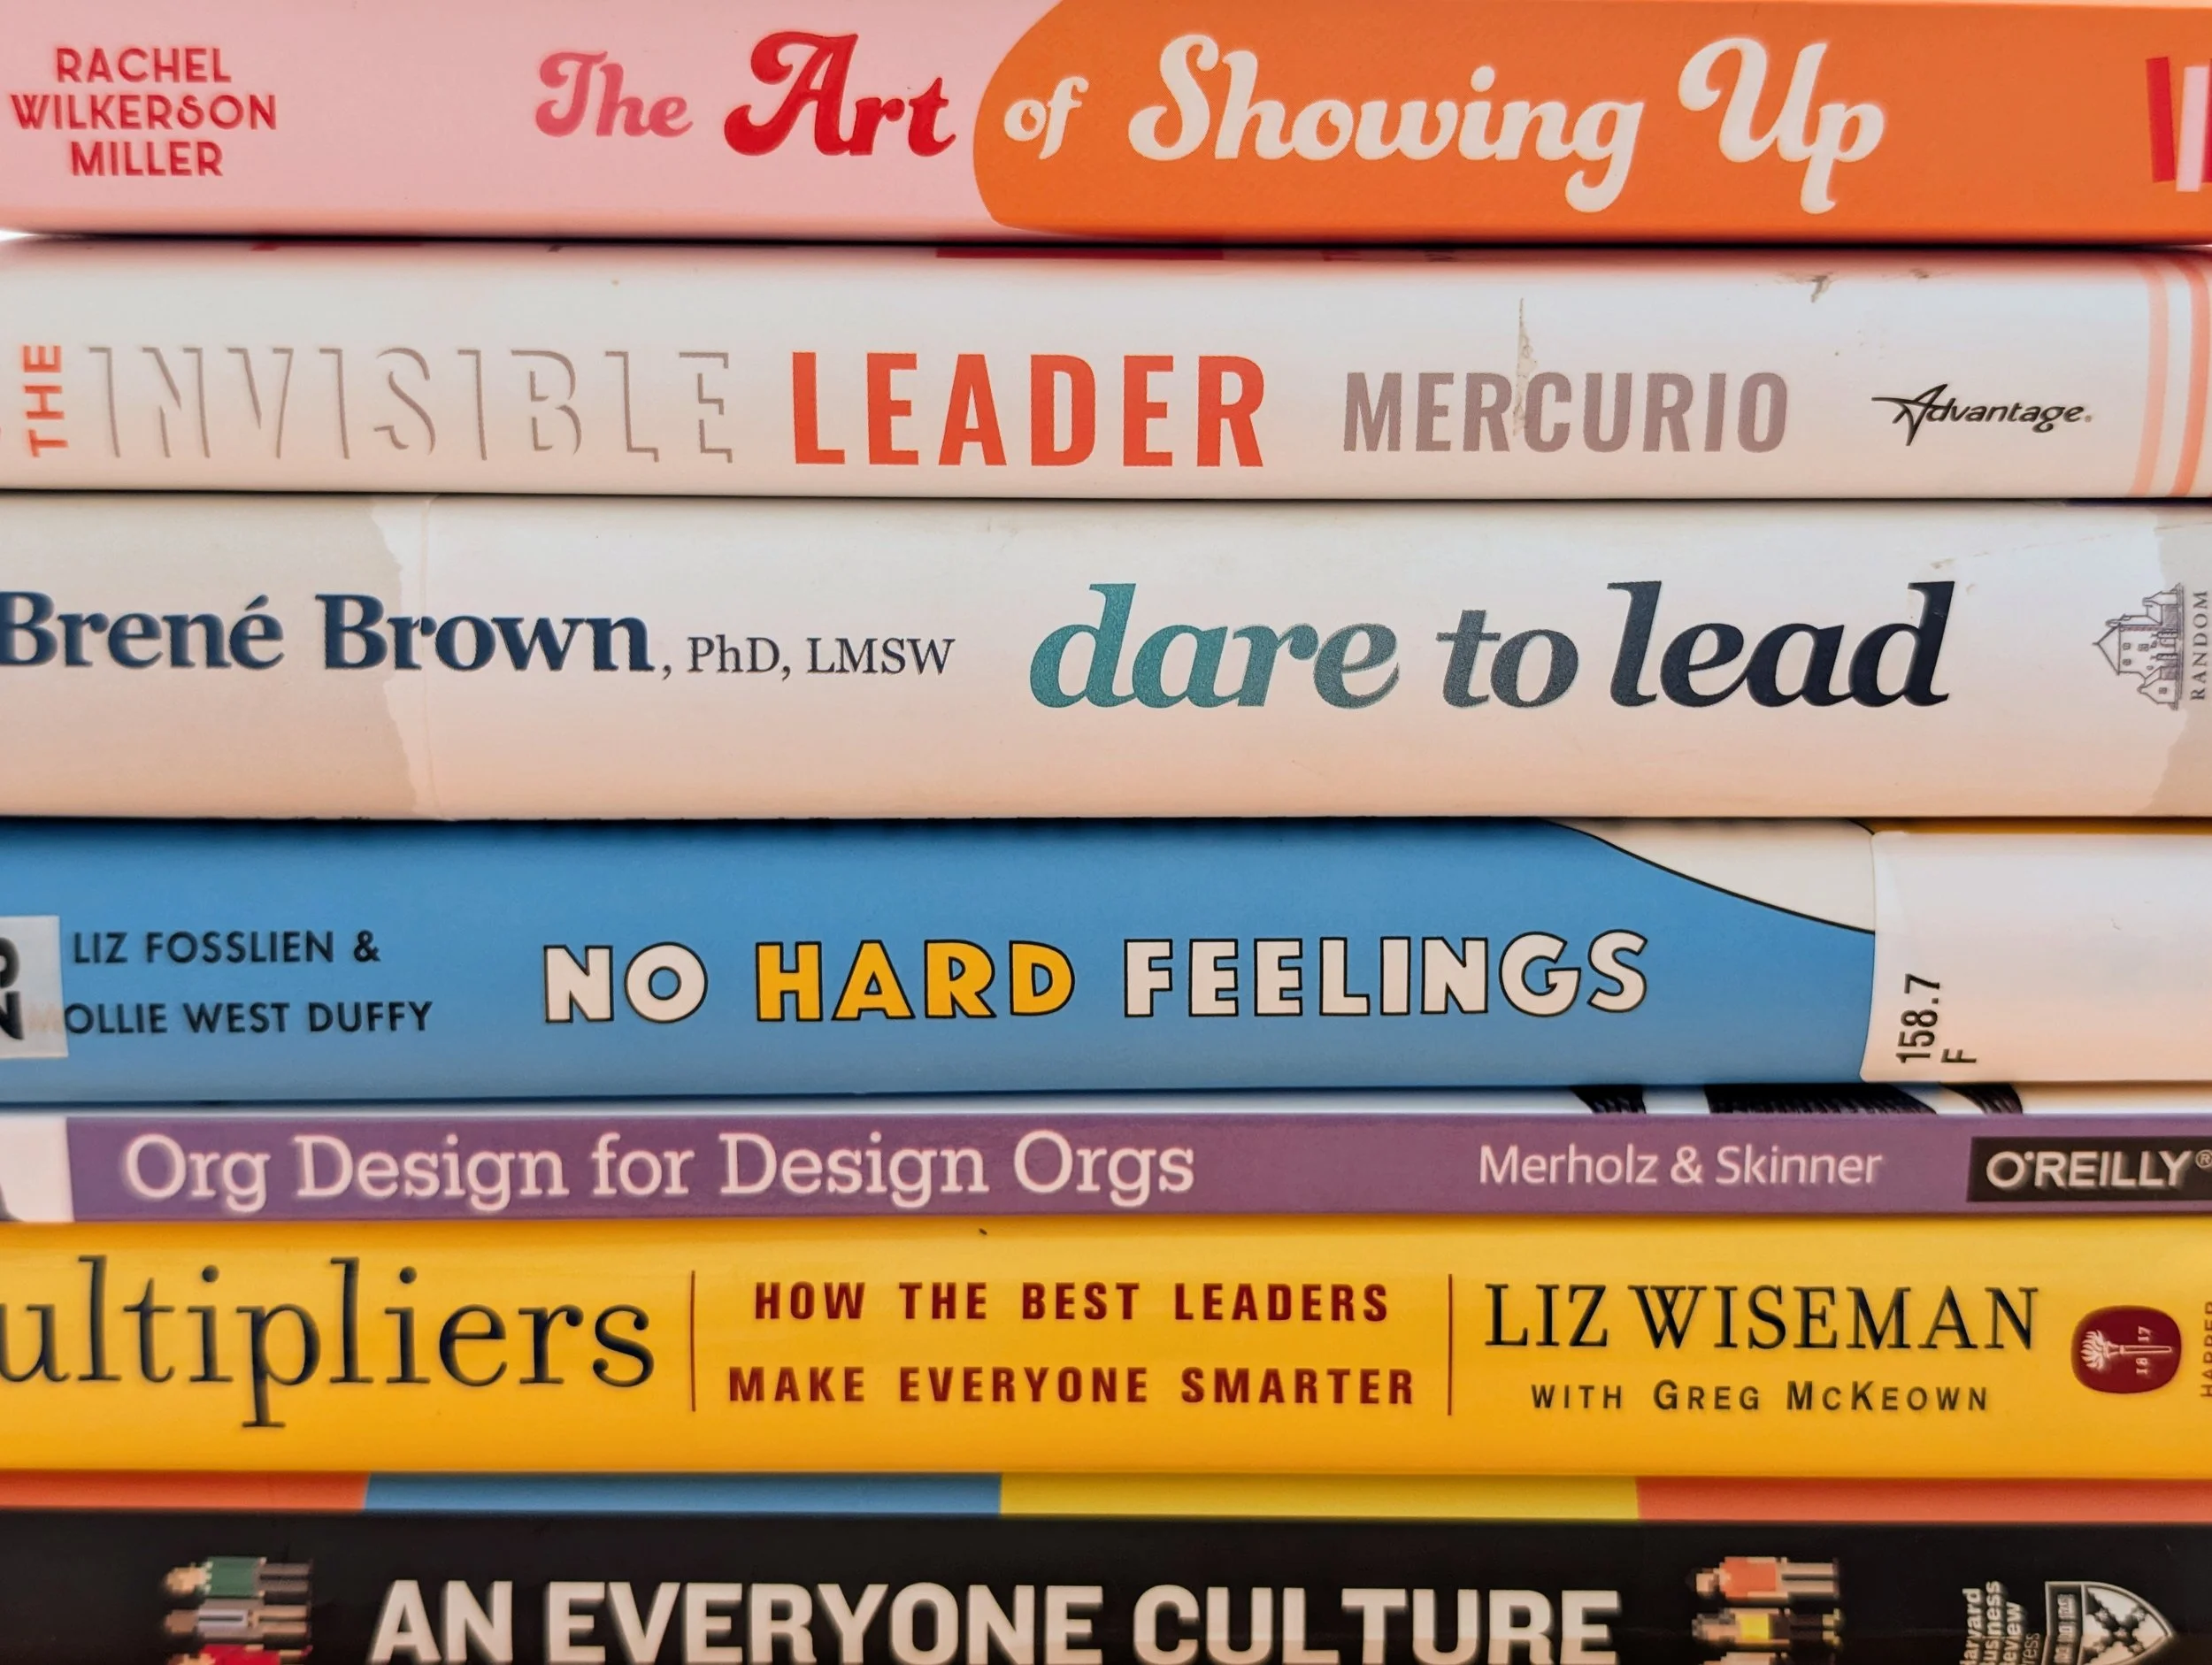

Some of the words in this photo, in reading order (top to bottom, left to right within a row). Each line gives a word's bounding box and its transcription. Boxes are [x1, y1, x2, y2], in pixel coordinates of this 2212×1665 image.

[56, 47, 232, 83] RACHEL
[11, 94, 277, 130] WILKERSON
[534, 50, 694, 138] The
[724, 32, 956, 157] Art
[1002, 76, 1088, 160] of
[1128, 34, 1644, 212] Showing
[1678, 37, 1884, 214] Up
[71, 141, 223, 176] MILLER
[22, 345, 68, 457] THE
[88, 347, 733, 463] INVISIBLE
[792, 351, 1264, 468] LEADER
[1343, 372, 1787, 453] MERCURIO
[0, 591, 285, 670] Brené
[315, 593, 672, 680] Brown,
[687, 636, 791, 681] PhD,
[807, 637, 956, 675] LMSW
[1029, 582, 1400, 709] dare
[1436, 609, 1579, 708] to
[1607, 579, 1955, 708] lead
[2190, 591, 2208, 701] RANDOM
[74, 932, 128, 963] LIZ
[145, 930, 334, 964] FOSSLIEN
[354, 930, 381, 964] &
[542, 940, 709, 1024] NO
[755, 939, 1076, 1023] HARD
[1123, 929, 1648, 1018] FEELINGS
[62, 1001, 168, 1035] OLLIE
[183, 1001, 288, 1034] WEST
[308, 1000, 434, 1034] DUFFY
[1895, 973, 1940, 1063] 158.7
[1940, 1048, 1978, 1063] F
[124, 1133, 271, 1213] Org
[294, 1133, 569, 1213] Design
[590, 1132, 695, 1197] for
[718, 1132, 990, 1209] Design
[1013, 1129, 1195, 1208] Orgs
[1479, 1143, 1660, 1186] Merholz
[1670, 1144, 1704, 1186] &
[1714, 1143, 1884, 1187] Skinner
[755, 1281, 866, 1321] HOW
[899, 1282, 988, 1321] THE
[1021, 1282, 1141, 1321] BEST
[1174, 1283, 1389, 1324] LEADERS
[1484, 1282, 1609, 1348] LIZ
[1628, 1285, 2039, 1351] WISEMAN
[728, 1366, 866, 1402] MAKE
[899, 1366, 1149, 1404] EVERYONE
[1180, 1368, 1414, 1406] SMARTER
[1531, 1384, 1622, 1410] WITH
[369, 1579, 513, 1665] AN
[546, 1580, 1103, 1665] EVERYONE
[1133, 1584, 1620, 1665] CULTURE
[1960, 1588, 1982, 1665] arvard
[1979, 1580, 2001, 1665] usiness
[1999, 1601, 2022, 1665] eview
